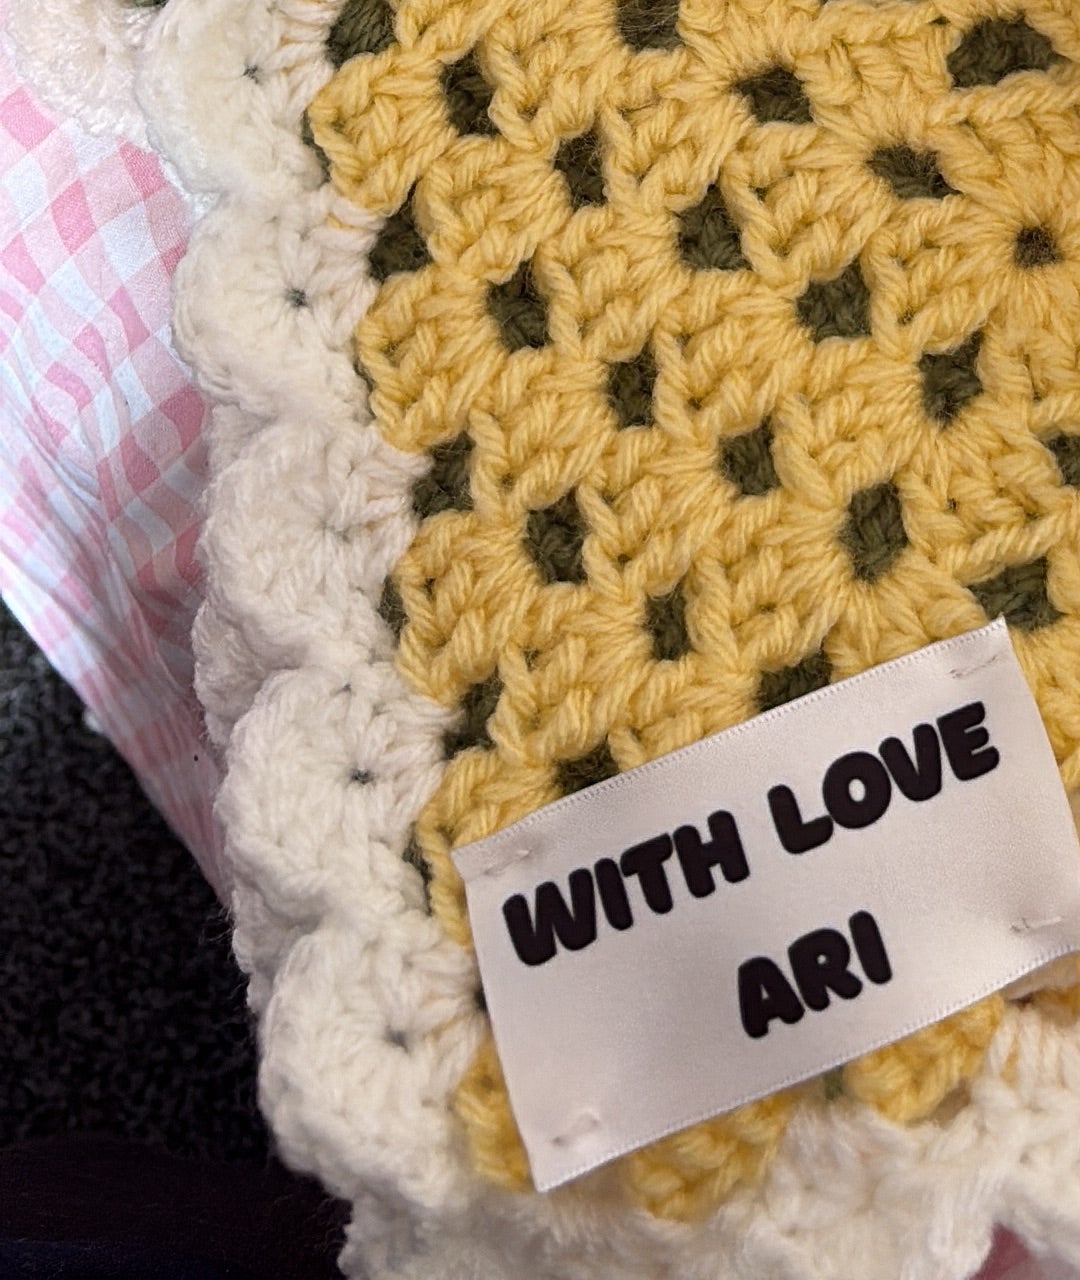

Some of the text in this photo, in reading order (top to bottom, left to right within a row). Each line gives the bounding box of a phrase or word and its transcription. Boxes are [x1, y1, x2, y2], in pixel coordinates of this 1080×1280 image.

[502, 701, 1000, 966] WITH LOVE
[737, 911, 892, 1039] ARI
